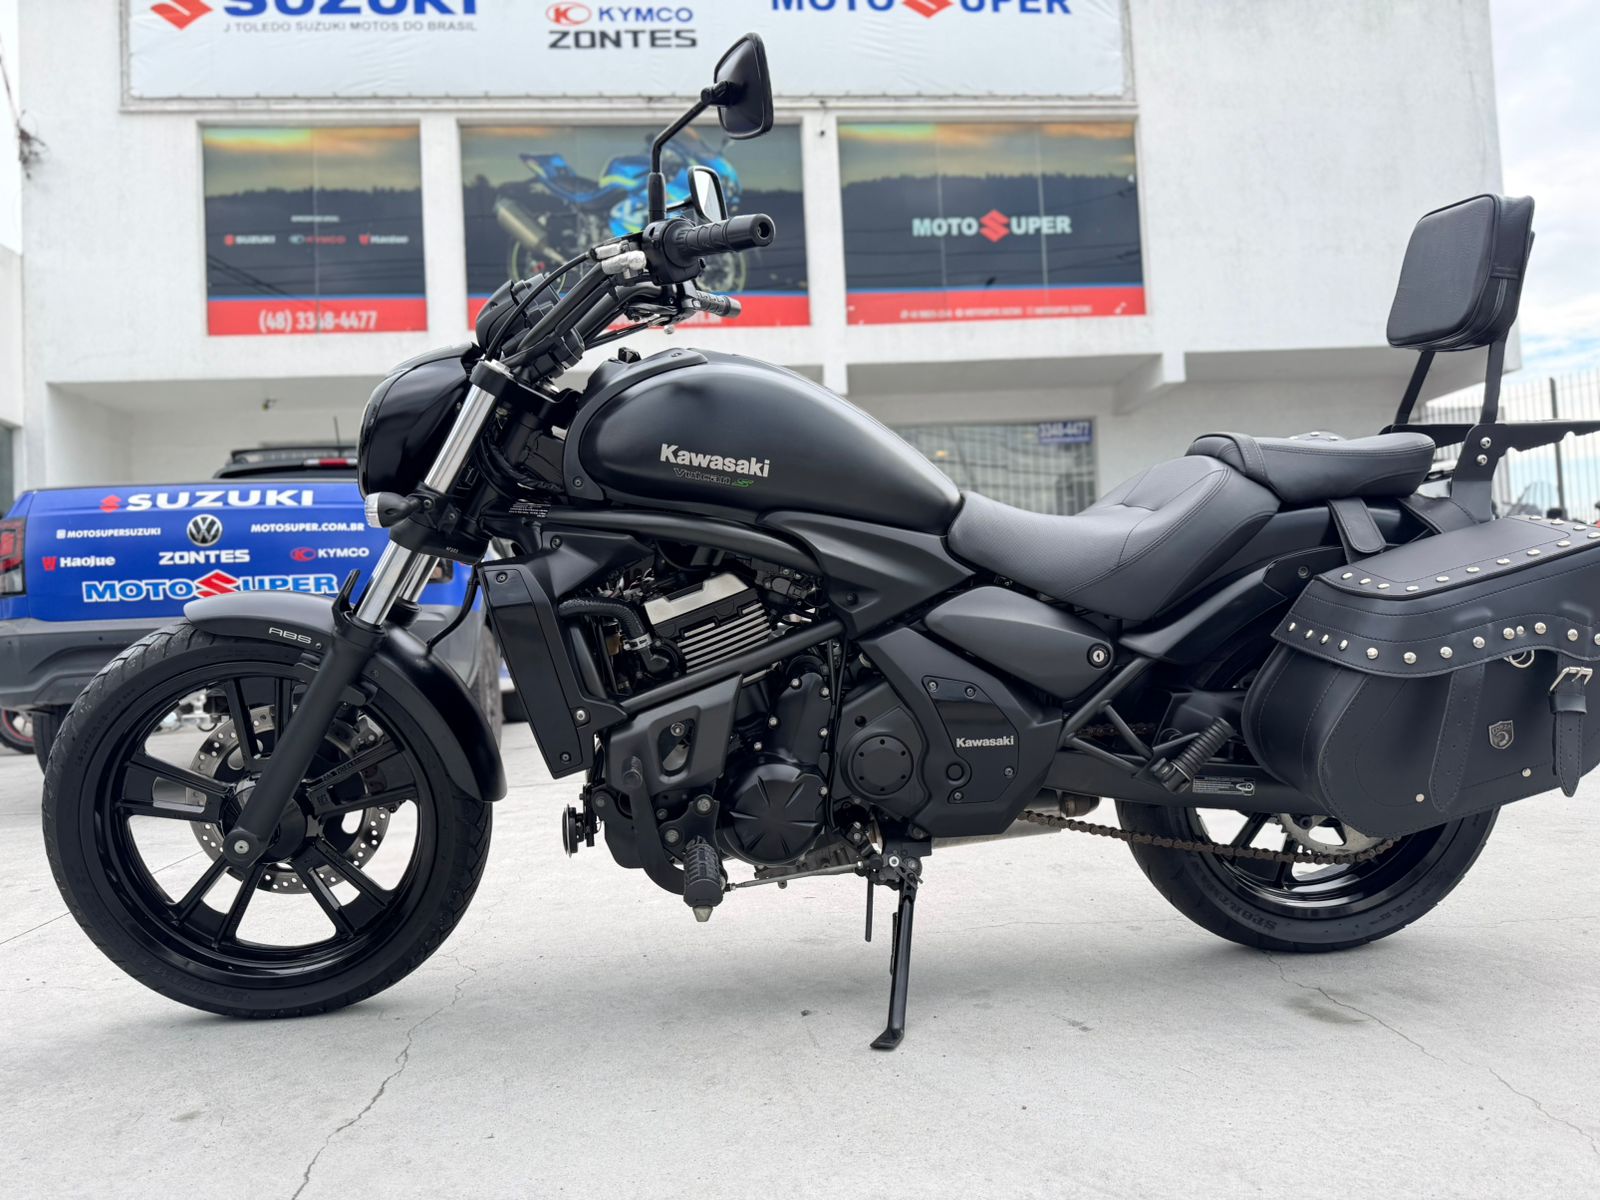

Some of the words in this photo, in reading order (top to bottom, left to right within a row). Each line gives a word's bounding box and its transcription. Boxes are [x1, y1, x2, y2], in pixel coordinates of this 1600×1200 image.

[598, 7, 694, 22] KYMCO
[223, 22, 231, 33] J
[235, 21, 291, 32] TOLEDO
[295, 21, 345, 31] SUZUKI
[349, 20, 400, 31] MOTOS
[403, 20, 423, 31] DO
[427, 20, 477, 31] BRASIL
[548, 29, 697, 49] ZONTES
[259, 308, 292, 333] (48)
[660, 443, 770, 477] Kawasaki
[673, 467, 731, 485] Vulcan
[126, 490, 314, 511] SUZUKI
[67, 527, 162, 538] MOTOSUPERSUZUKI
[251, 522, 365, 533] MOTOSUPER.COM.BR
[158, 549, 250, 566] ZONTES
[318, 547, 370, 558] KYMCO
[268, 627, 312, 644] ABS
[956, 735, 1014, 748] Kawasaki
